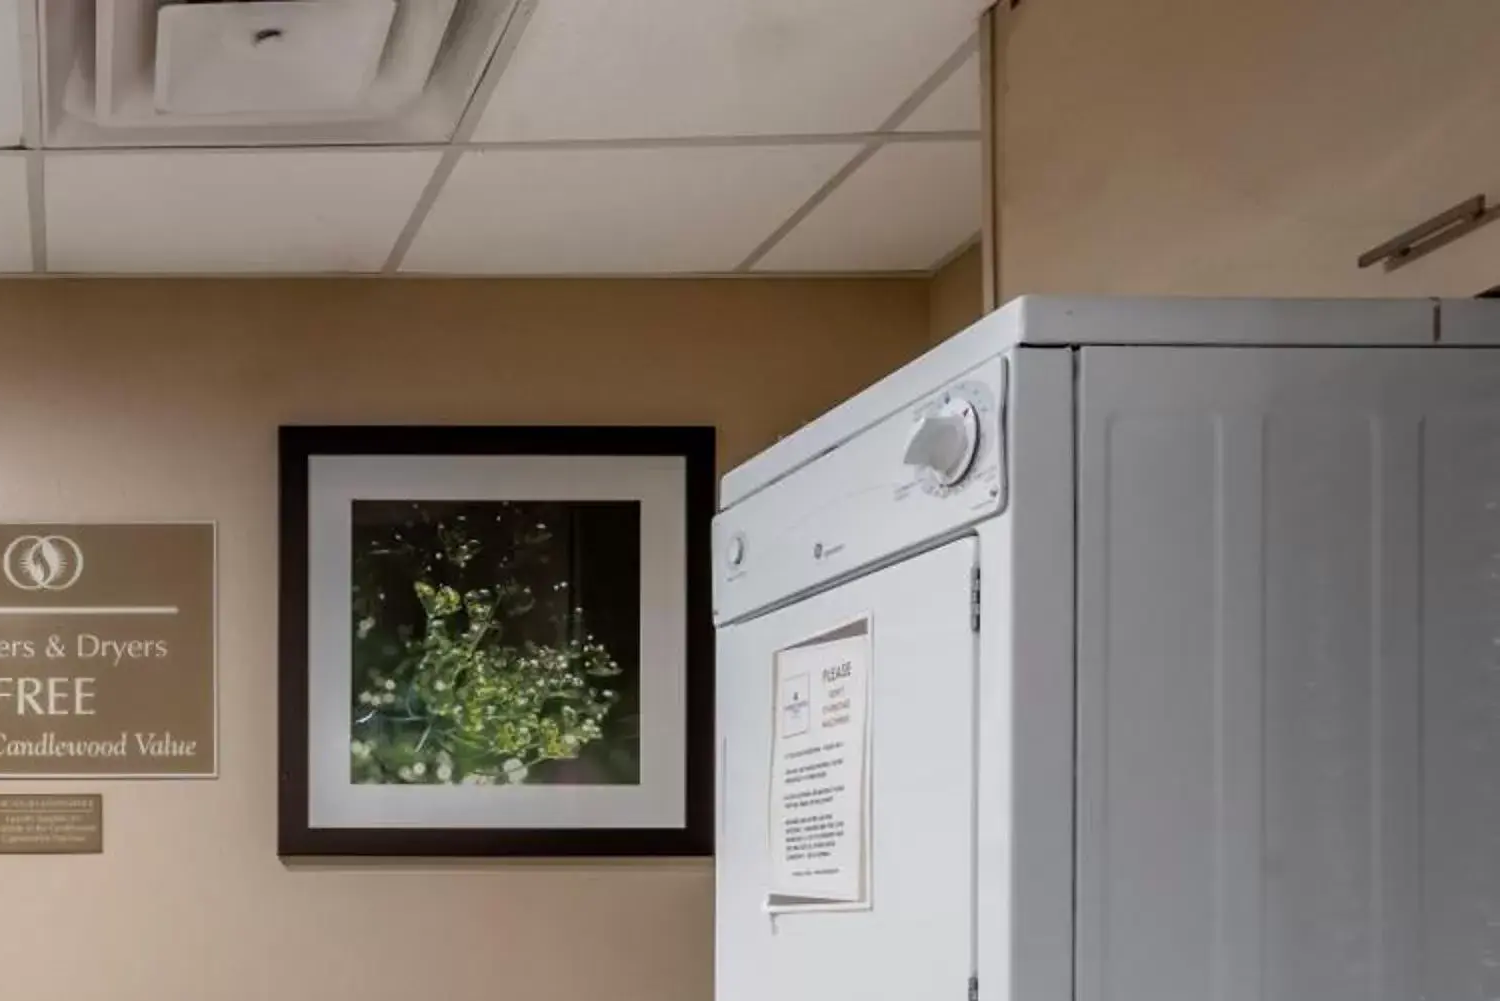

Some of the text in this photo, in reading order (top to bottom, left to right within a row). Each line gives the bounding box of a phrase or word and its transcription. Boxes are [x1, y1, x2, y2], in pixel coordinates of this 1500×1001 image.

[45, 634, 66, 657] &
[76, 634, 169, 667] Dryers
[133, 733, 197, 757] Value
